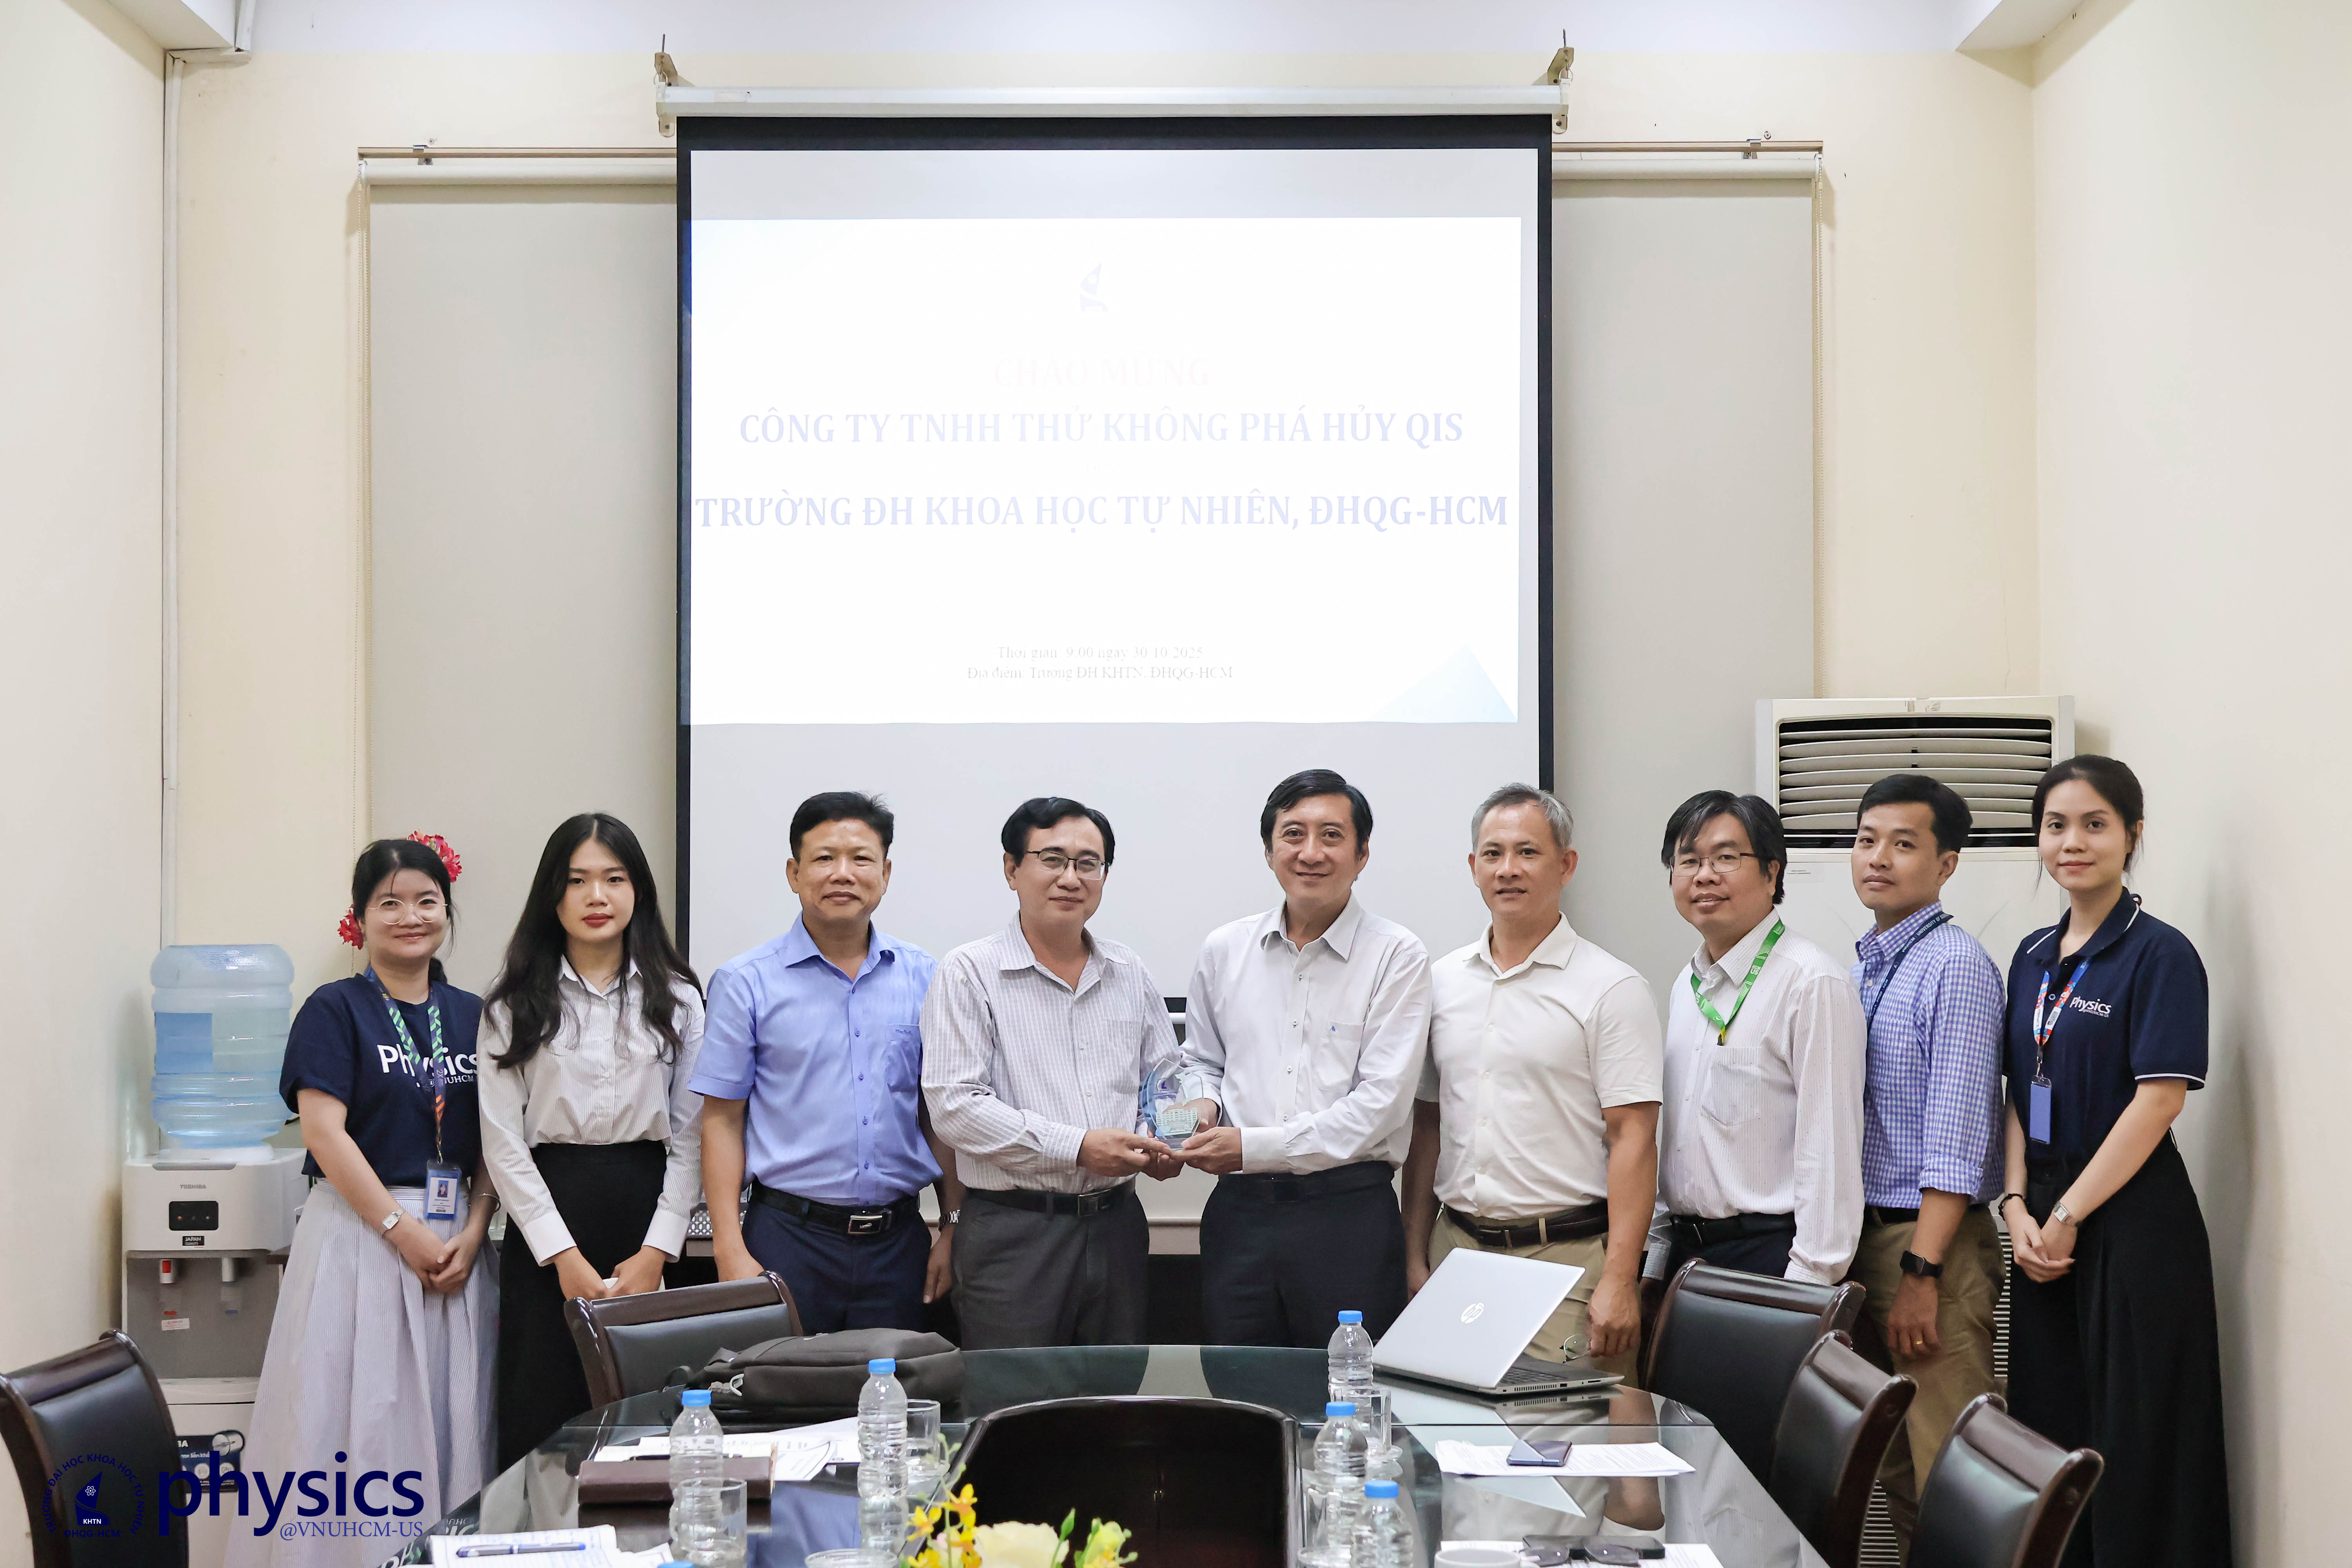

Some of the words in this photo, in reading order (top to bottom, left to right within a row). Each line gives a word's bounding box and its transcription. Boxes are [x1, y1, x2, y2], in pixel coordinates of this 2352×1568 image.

[740, 406, 835, 443] CÔNG
[845, 414, 891, 443] TY
[900, 414, 1001, 442] TNHH
[1012, 405, 1093, 442] THỬ
[1103, 405, 1228, 442] KHÔNG
[1240, 404, 1312, 442] PHÁ
[1323, 404, 1397, 442] HỦY
[1406, 413, 1463, 449] QIS
[695, 488, 852, 527] TRƯỜNG
[862, 496, 913, 526] ĐH
[925, 496, 1025, 526] KHOA
[1035, 496, 1107, 534] HỌC
[1117, 496, 1171, 533] TỰ
[1180, 488, 1299, 530] NHIÊN,
[1308, 495, 1508, 532] ĐHQG-HCM
[1066, 646, 1094, 658] 9:00
[1076, 666, 1098, 678] ĐH
[2069, 996, 2112, 1014] Physics
